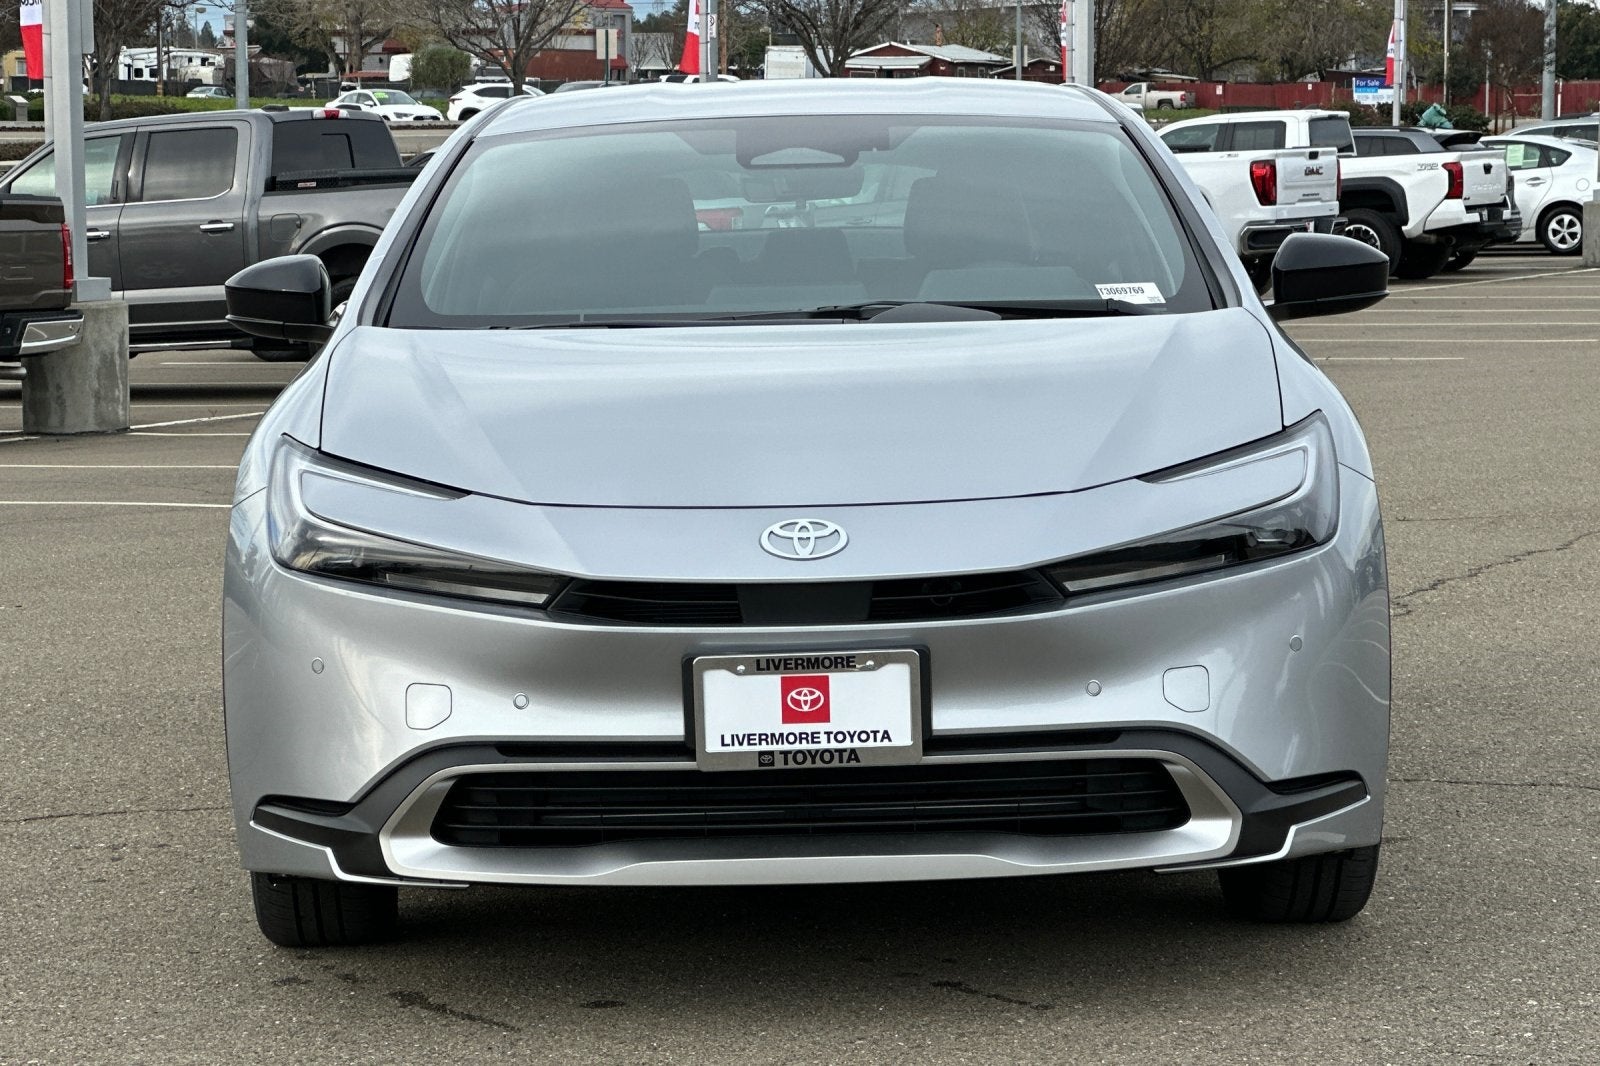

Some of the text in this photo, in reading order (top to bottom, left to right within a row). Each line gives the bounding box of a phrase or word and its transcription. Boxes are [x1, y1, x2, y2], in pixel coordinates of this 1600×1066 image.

[1304, 166, 1323, 176] GMC
[755, 656, 857, 672] LIVERMORE
[720, 730, 892, 747] LIVERMORE TOYOTA
[779, 748, 861, 766] TOYOTA
